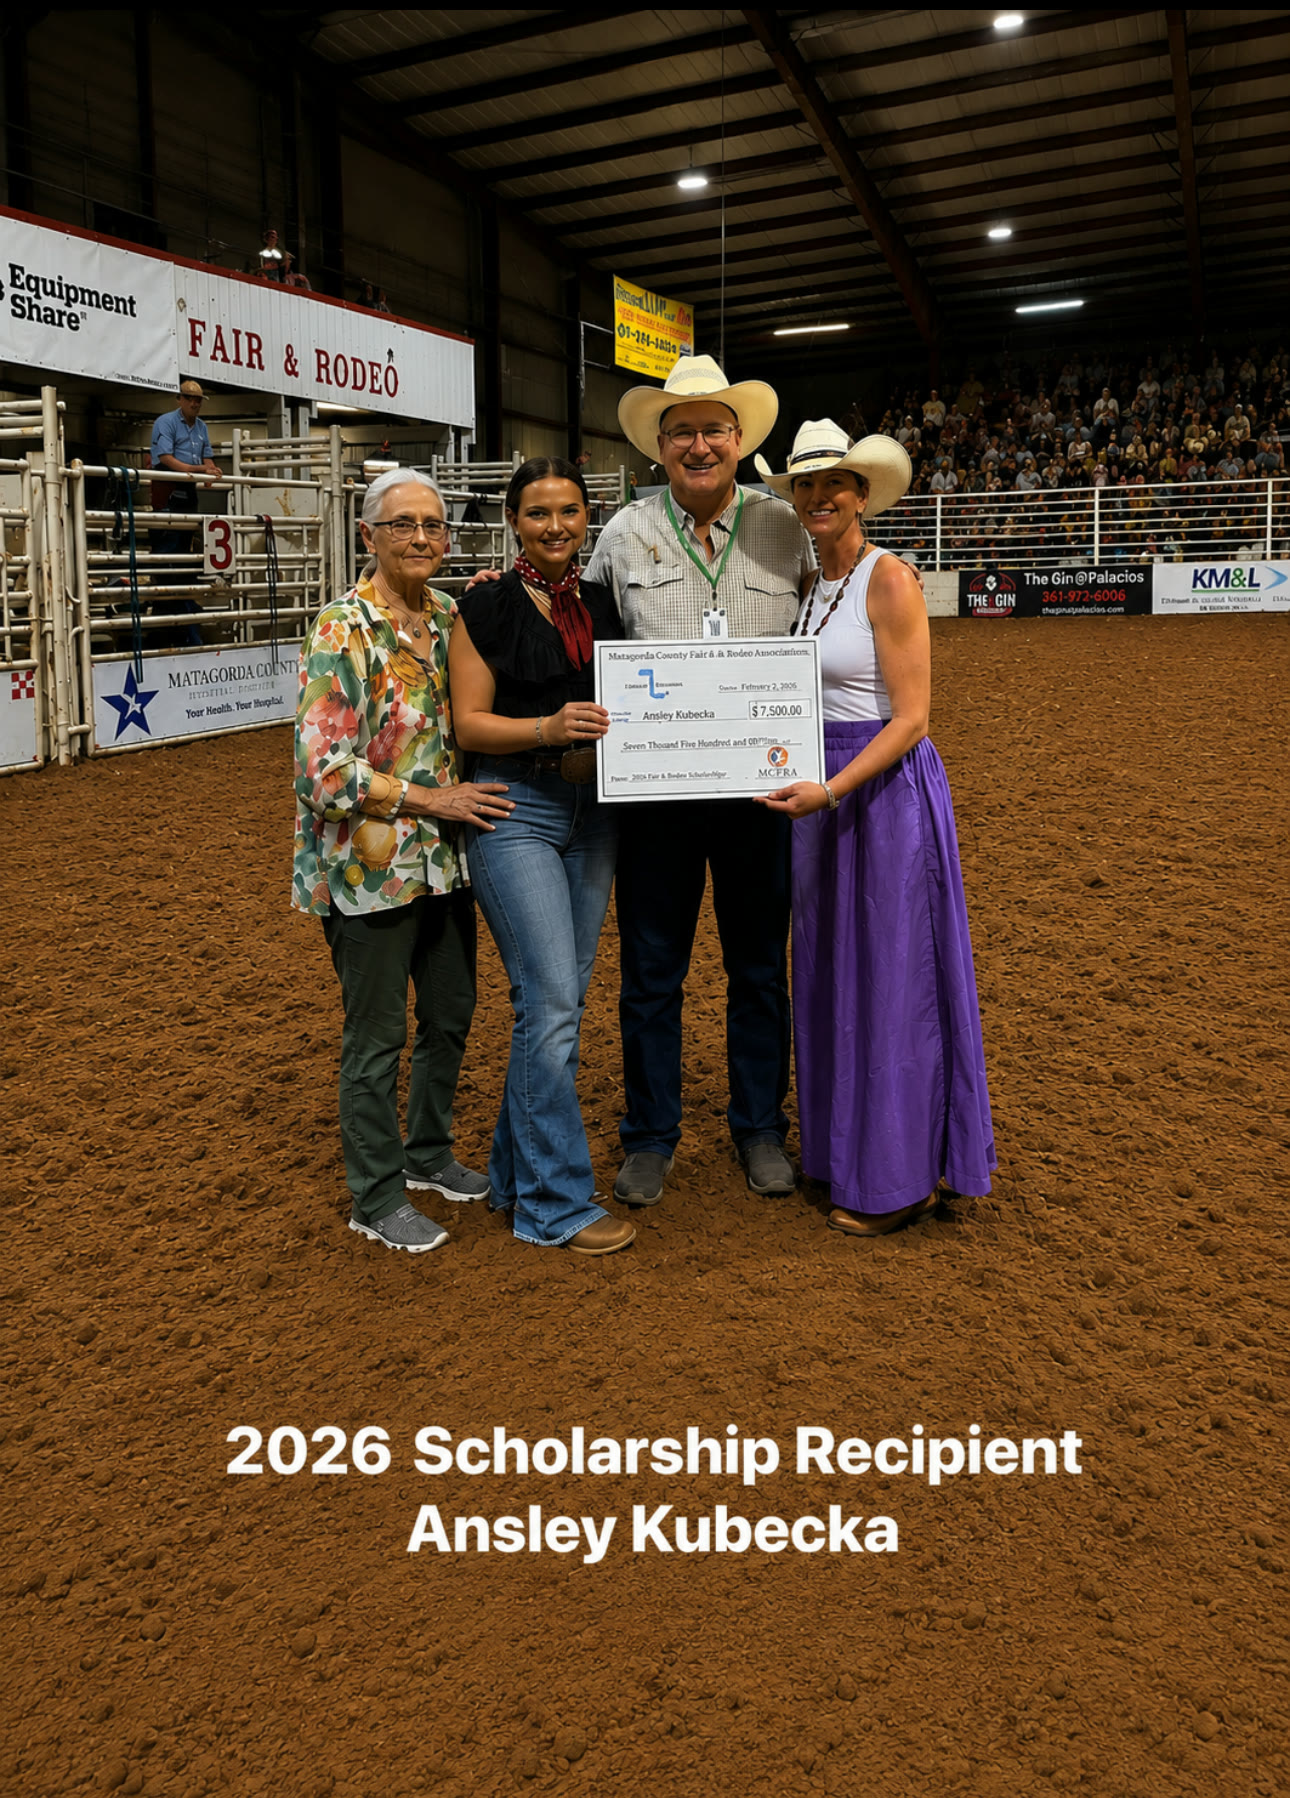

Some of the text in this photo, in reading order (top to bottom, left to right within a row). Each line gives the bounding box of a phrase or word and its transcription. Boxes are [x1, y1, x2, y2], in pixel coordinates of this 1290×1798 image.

[8, 263, 137, 318] Equipment
[10, 293, 81, 332] Share
[188, 318, 399, 398] FAIR & RODEO
[208, 519, 233, 570] 3
[1024, 572, 1049, 585] The
[1192, 567, 1261, 589] KM&L
[967, 593, 1016, 607] THE GIN
[1042, 589, 1126, 603] 361-972-6006
[656, 651, 688, 661] County
[727, 648, 753, 658] Rodeo
[168, 665, 255, 689] MATAGORDA
[642, 710, 674, 721] Ansley
[675, 709, 715, 719] Kubecka
[623, 741, 646, 750] Seven
[681, 740, 696, 748] Five
[733, 738, 747, 746] and
[758, 768, 798, 777] MCFRA
